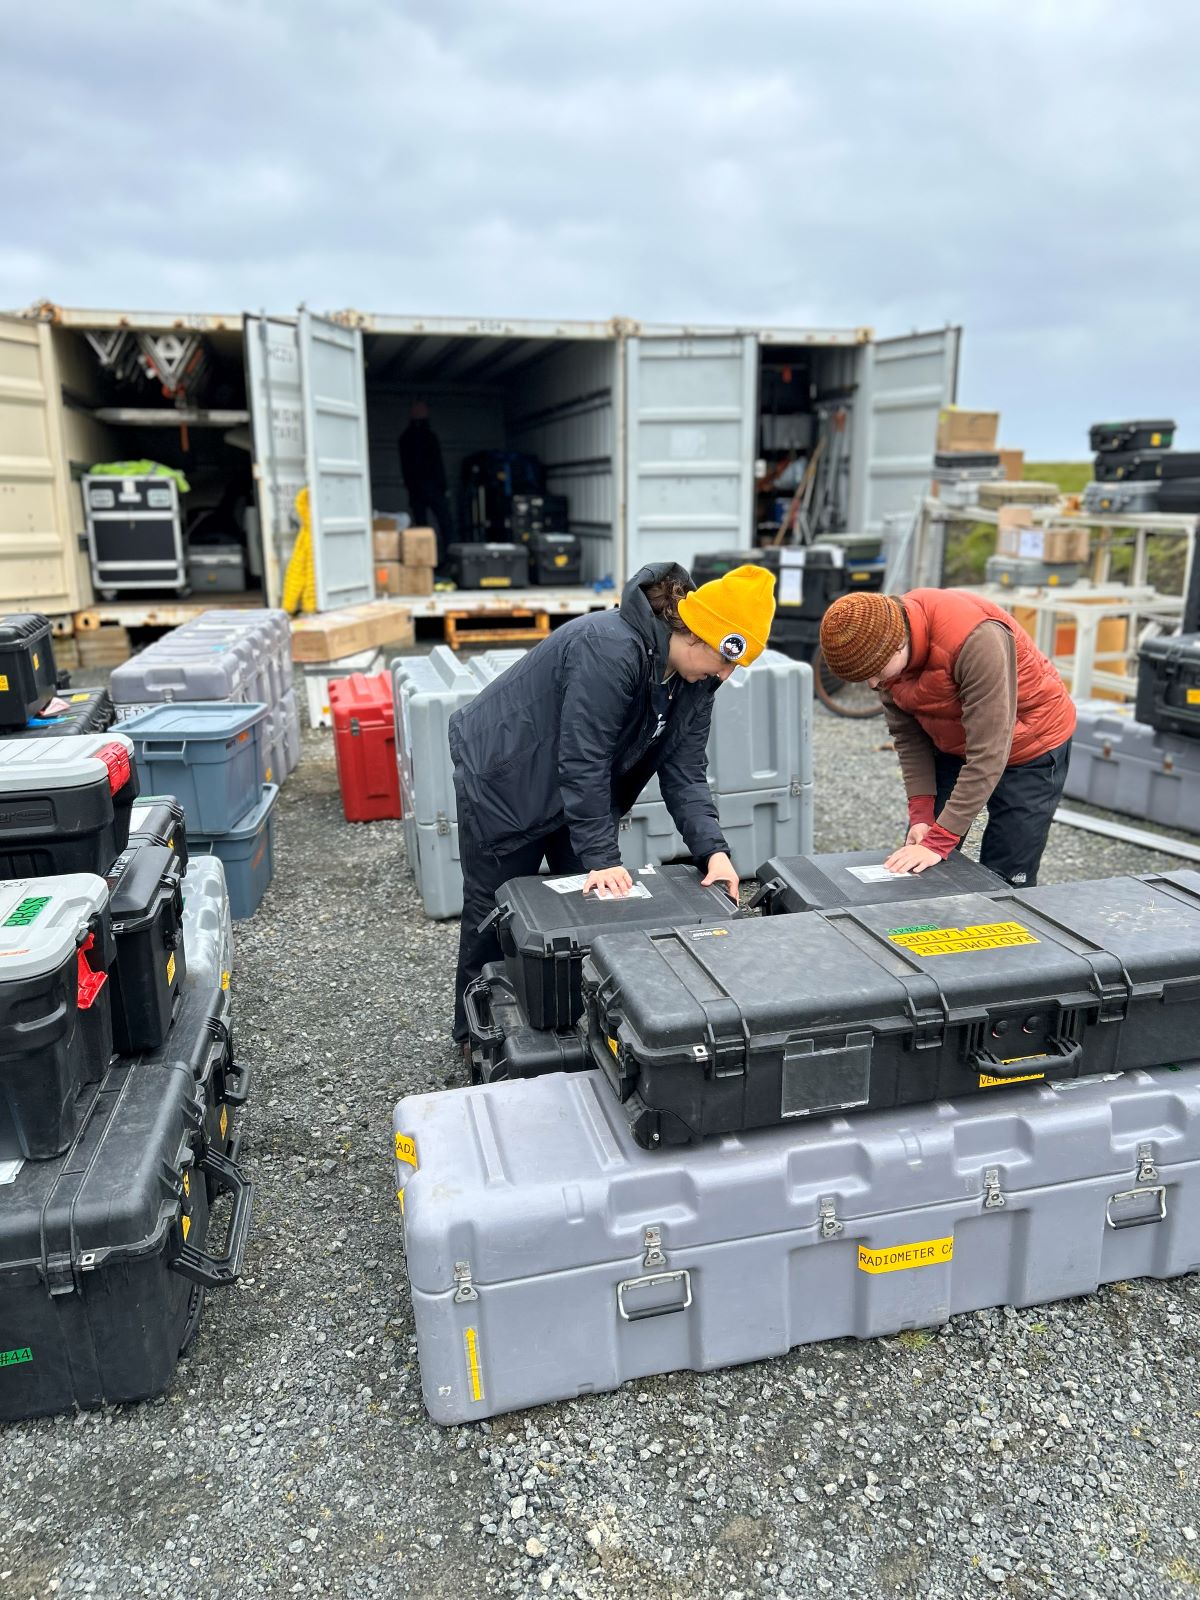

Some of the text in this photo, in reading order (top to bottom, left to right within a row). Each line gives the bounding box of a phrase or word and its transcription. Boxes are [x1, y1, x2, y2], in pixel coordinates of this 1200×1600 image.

[3, 896, 50, 926] BRSS
[891, 924, 1019, 945] VENTILATORS
[917, 934, 1036, 955] RADIOMETER
[395, 1141, 415, 1157] ADI
[860, 1247, 934, 1266] RADIOMETER
